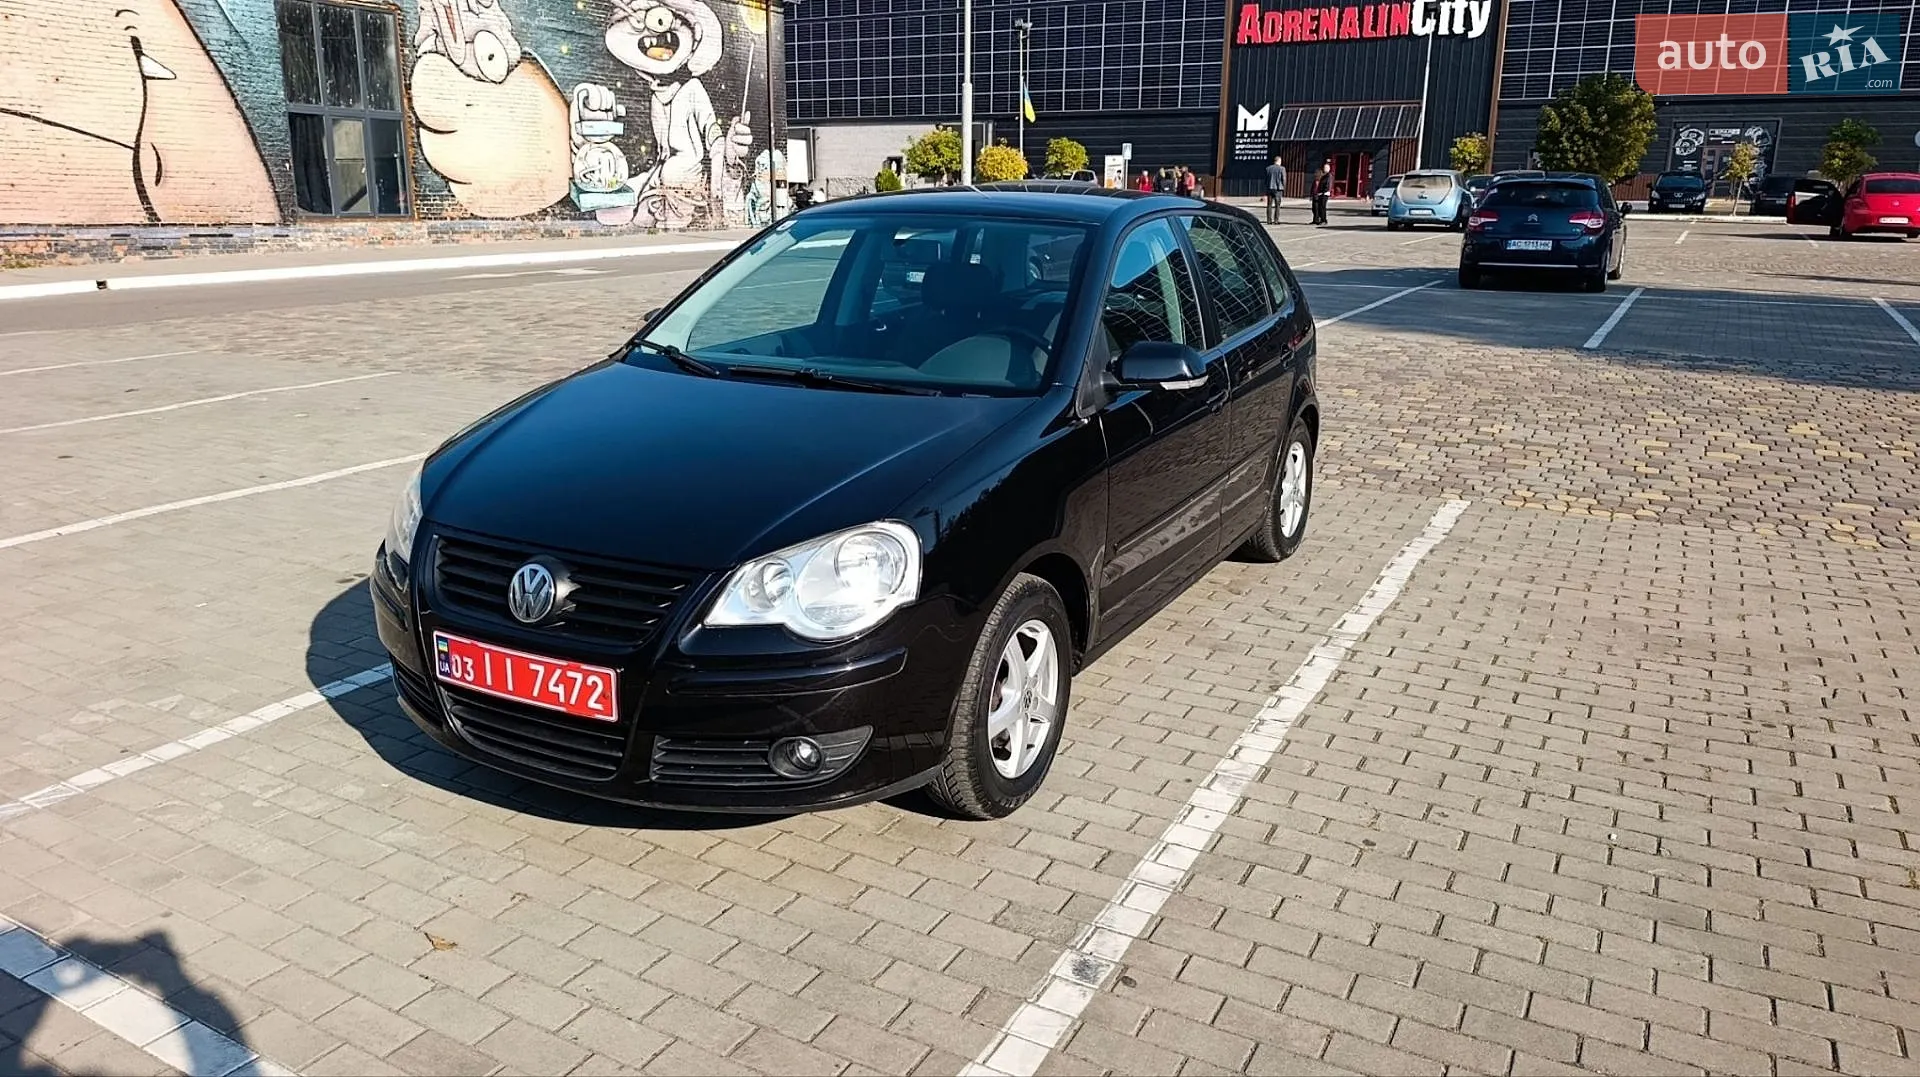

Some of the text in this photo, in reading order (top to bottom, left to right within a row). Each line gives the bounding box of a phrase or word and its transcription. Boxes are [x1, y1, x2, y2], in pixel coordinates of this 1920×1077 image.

[439, 660, 451, 674] UA
[451, 654, 474, 682] 03
[529, 663, 604, 710] 7472
